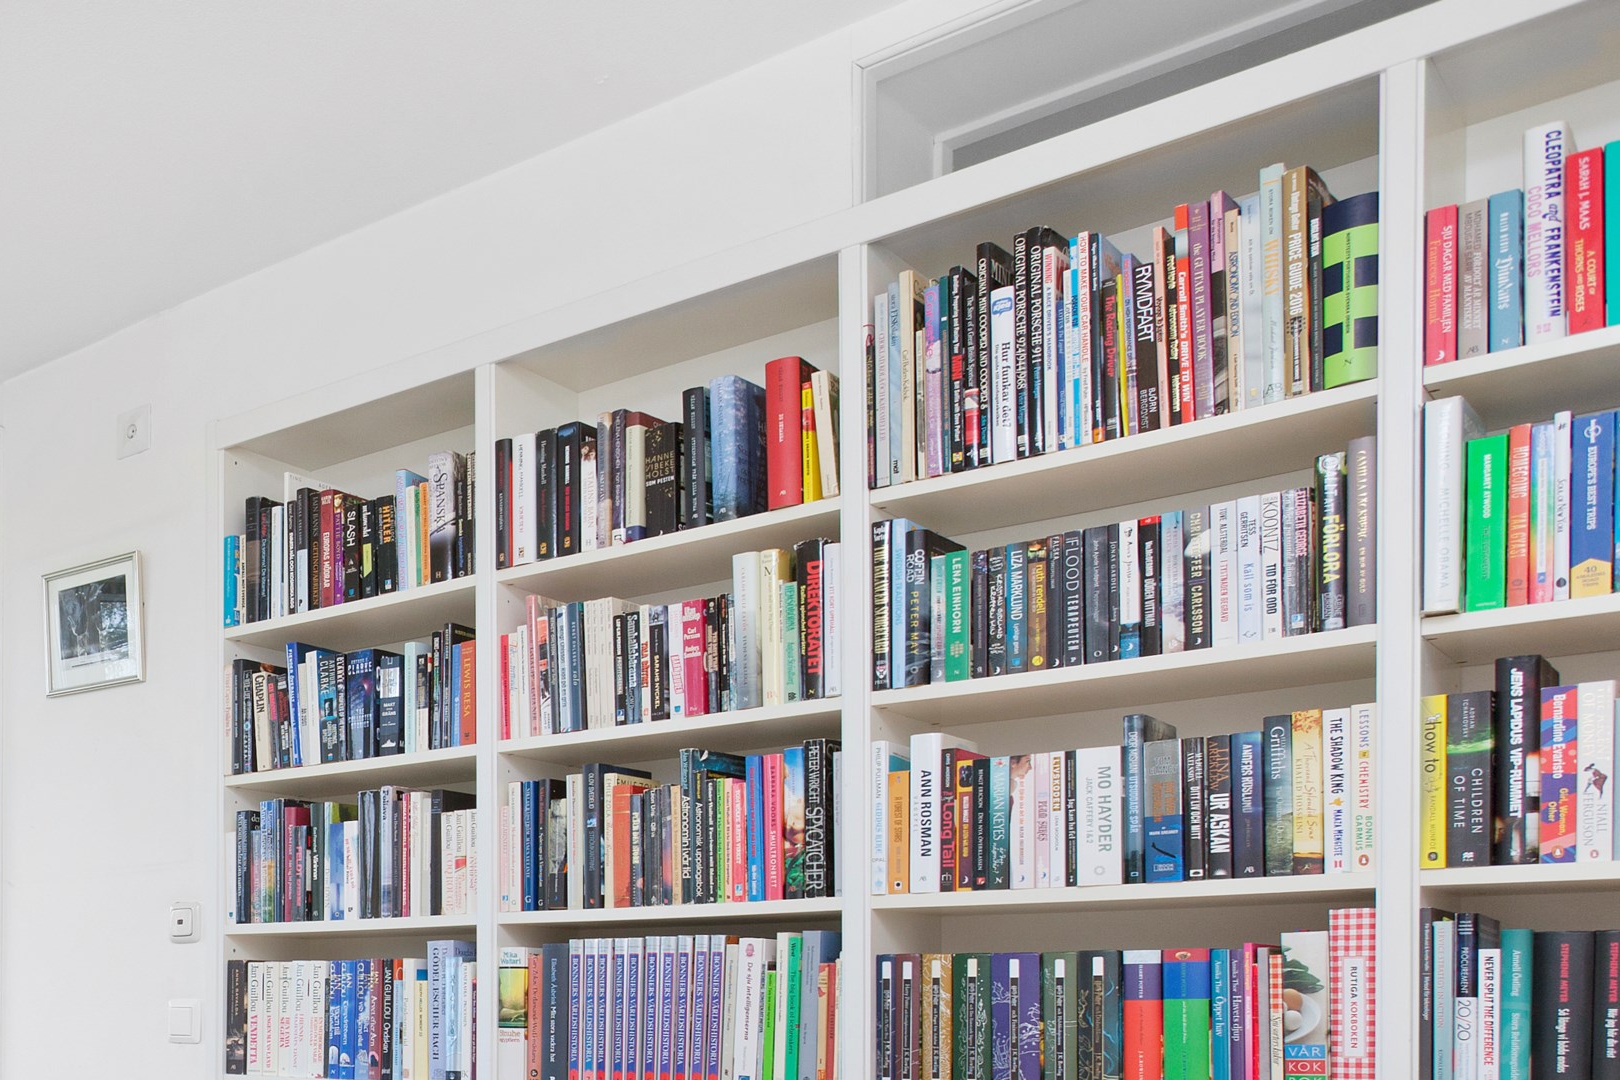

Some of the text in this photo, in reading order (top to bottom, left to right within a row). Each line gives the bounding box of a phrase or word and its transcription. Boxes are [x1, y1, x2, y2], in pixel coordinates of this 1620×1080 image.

[1080, 236, 1088, 252] HOW
[1527, 186, 1542, 277] COCO MELLORS
[1542, 131, 1561, 316] CLEOPATRA and FRANKENSTEIN
[1045, 254, 1053, 284] WINNING
[1081, 255, 1088, 266] TO
[1081, 269, 1089, 289] MAKE
[1288, 232, 1303, 315] PRICE GUIDE 2016
[1441, 226, 1452, 332] SJU DAGAR MED FAMILJEN
[1030, 245, 1041, 364] ORIGINAL PORSCHE 911
[1081, 292, 1089, 312] YOUR
[1135, 265, 1153, 342] RYMDFART
[1082, 333, 1090, 363] HANDLE
[1105, 295, 1116, 377] The Racing Driver
[645, 450, 674, 464] HANNE
[645, 466, 674, 480] HOLST
[347, 511, 355, 546] SLASH
[382, 505, 392, 543] HITLER
[1240, 512, 1248, 547] GERRITSEN
[1248, 519, 1256, 536] TESS
[1263, 501, 1278, 553] KOONTZ
[906, 554, 915, 582] ROAD
[915, 550, 924, 584] COFFIN
[952, 557, 961, 584] LENA
[1323, 515, 1343, 583] FÖRLORA
[1011, 550, 1023, 620] LIZA MARKLUND
[1036, 564, 1045, 614] ruth rendell
[1191, 585, 1202, 634] CARLSSON
[1266, 563, 1278, 614] TID FÖR ODD
[807, 560, 823, 674] DIREKTORATET
[911, 591, 919, 655] PETER MAY
[952, 587, 961, 633] EINHORN
[1069, 595, 1079, 650] TERAPEUTEN
[255, 675, 265, 713] CHAPLIN
[319, 660, 329, 695] CLARKE
[1269, 727, 1284, 780] Griffiths
[1359, 710, 1369, 748] LESSONS
[1424, 721, 1442, 772] how to
[1510, 668, 1523, 818] JENS LAPIDUS VIP-RUMMET
[1552, 694, 1567, 779] Bernardine Evaristo
[1330, 718, 1343, 793] THE SHADOW KING
[1098, 766, 1112, 852] MO HAYDER
[1359, 761, 1369, 809] CHEMISTRY
[1453, 775, 1465, 828] OF TIME
[1471, 768, 1482, 833] CHILDREN
[805, 746, 824, 890] PETER WRIGHT SPYCATCHER
[921, 770, 932, 856] ANN ROSMAN
[941, 802, 954, 867] Long Tail
[1210, 793, 1229, 853] UR ASKAN
[1365, 816, 1373, 848] BONNIE
[1548, 801, 1557, 822] Other
[265, 965, 274, 1013] Jan Guillou
[1460, 947, 1469, 994] PROCUREMENT
[250, 963, 259, 1064] Jan Guillou VENDETTA
[314, 980, 322, 1014] Guillou
[383, 984, 391, 1019] GUILLOU
[694, 955, 705, 1065] BONNIERS VÄRLDSHISTORIA
[1350, 966, 1358, 1048] RUTIGA KOKBOKEN
[1457, 1000, 1471, 1041] 20/20
[1484, 956, 1494, 1065] NEVER SPLIT THE DIFFERENCE
[382, 1022, 390, 1053] Ondskan
[1288, 1045, 1322, 1057] VÅR
[1288, 1061, 1322, 1072] KOK
